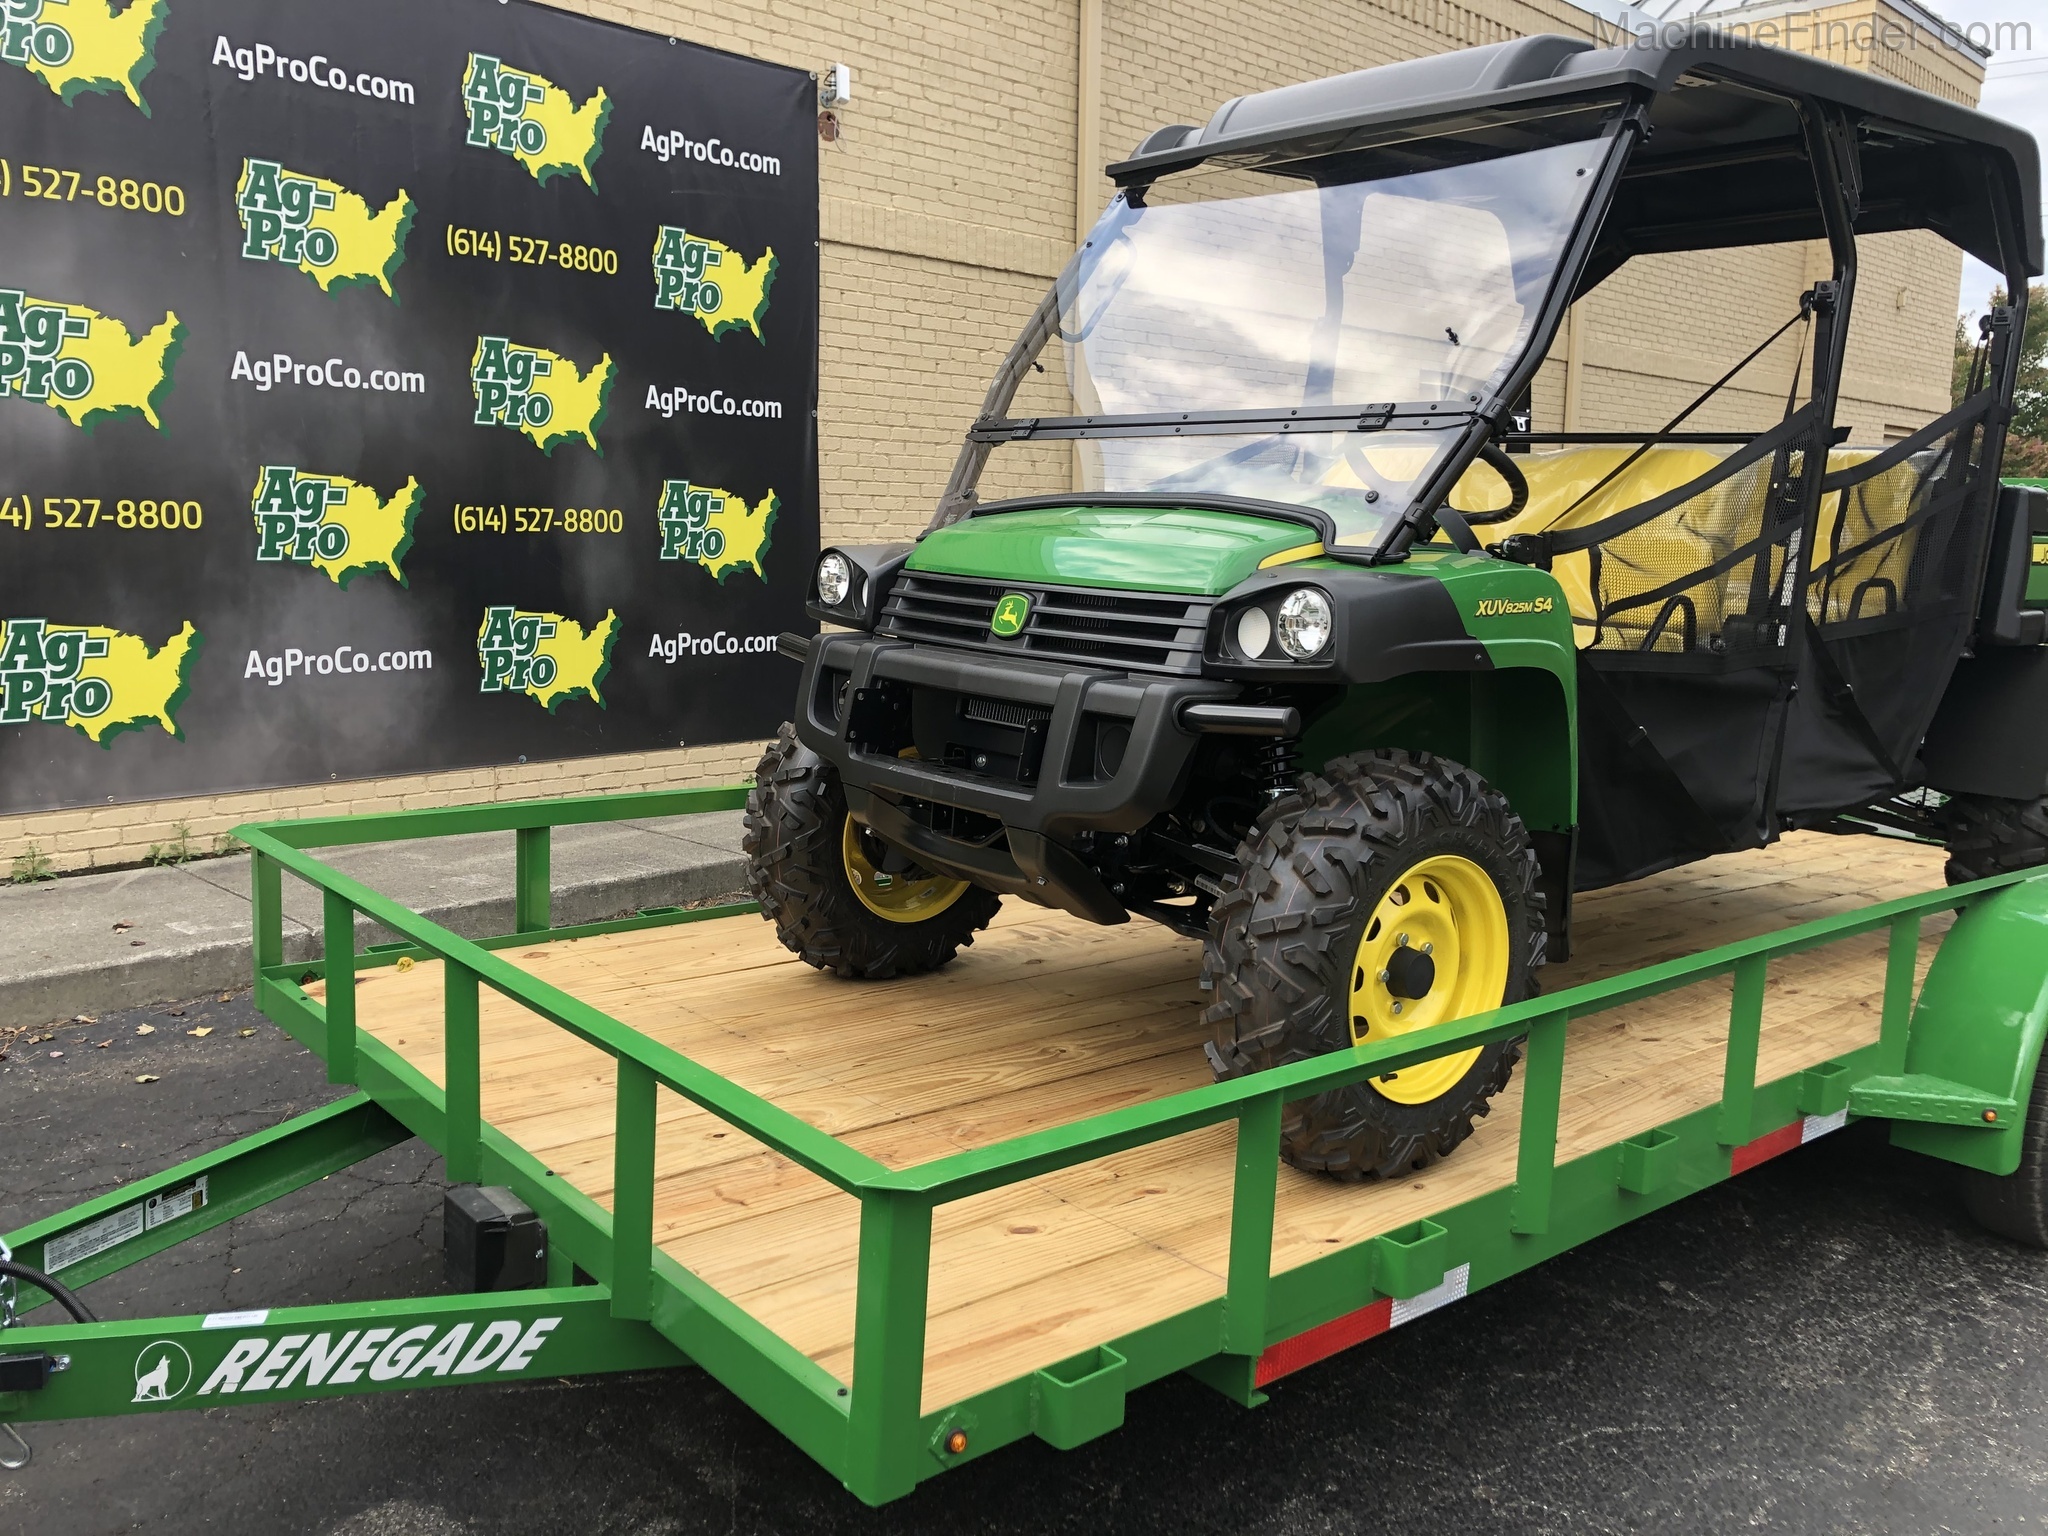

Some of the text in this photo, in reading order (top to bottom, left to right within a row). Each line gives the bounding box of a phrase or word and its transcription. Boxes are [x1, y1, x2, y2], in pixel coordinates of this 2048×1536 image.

[0, 6, 74, 66] ro
[212, 35, 415, 105] AgProCo.com
[465, 53, 545, 115] Ag-
[466, 101, 546, 155] Pro
[640, 125, 781, 176] AgProCo.com
[22, 165, 185, 216] 527-8800
[240, 159, 335, 227] Ag-
[242, 211, 337, 266] Pro
[447, 224, 618, 275] (614) 527-8800
[655, 226, 722, 278] Ag-
[655, 267, 722, 313] Pro
[231, 351, 425, 393] AgProCo.com
[474, 336, 552, 390] Ag-
[474, 380, 552, 427] Pro
[645, 384, 782, 419] AgProCo.com
[44, 498, 202, 530] 527-8800
[256, 466, 347, 523] Ag-
[454, 504, 623, 535] (614) 527-8800
[661, 480, 725, 528] Ag-
[257, 512, 350, 562] Pro
[660, 520, 725, 559] Pro
[482, 607, 557, 655] Ag-
[1475, 597, 1553, 616] XUV825M S4
[0, 619, 109, 680] Ag-
[244, 646, 432, 686] AgProCo.com
[480, 647, 557, 692] Pro
[0, 669, 113, 723] Pro
[198, 1316, 563, 1395] RENEGADE
